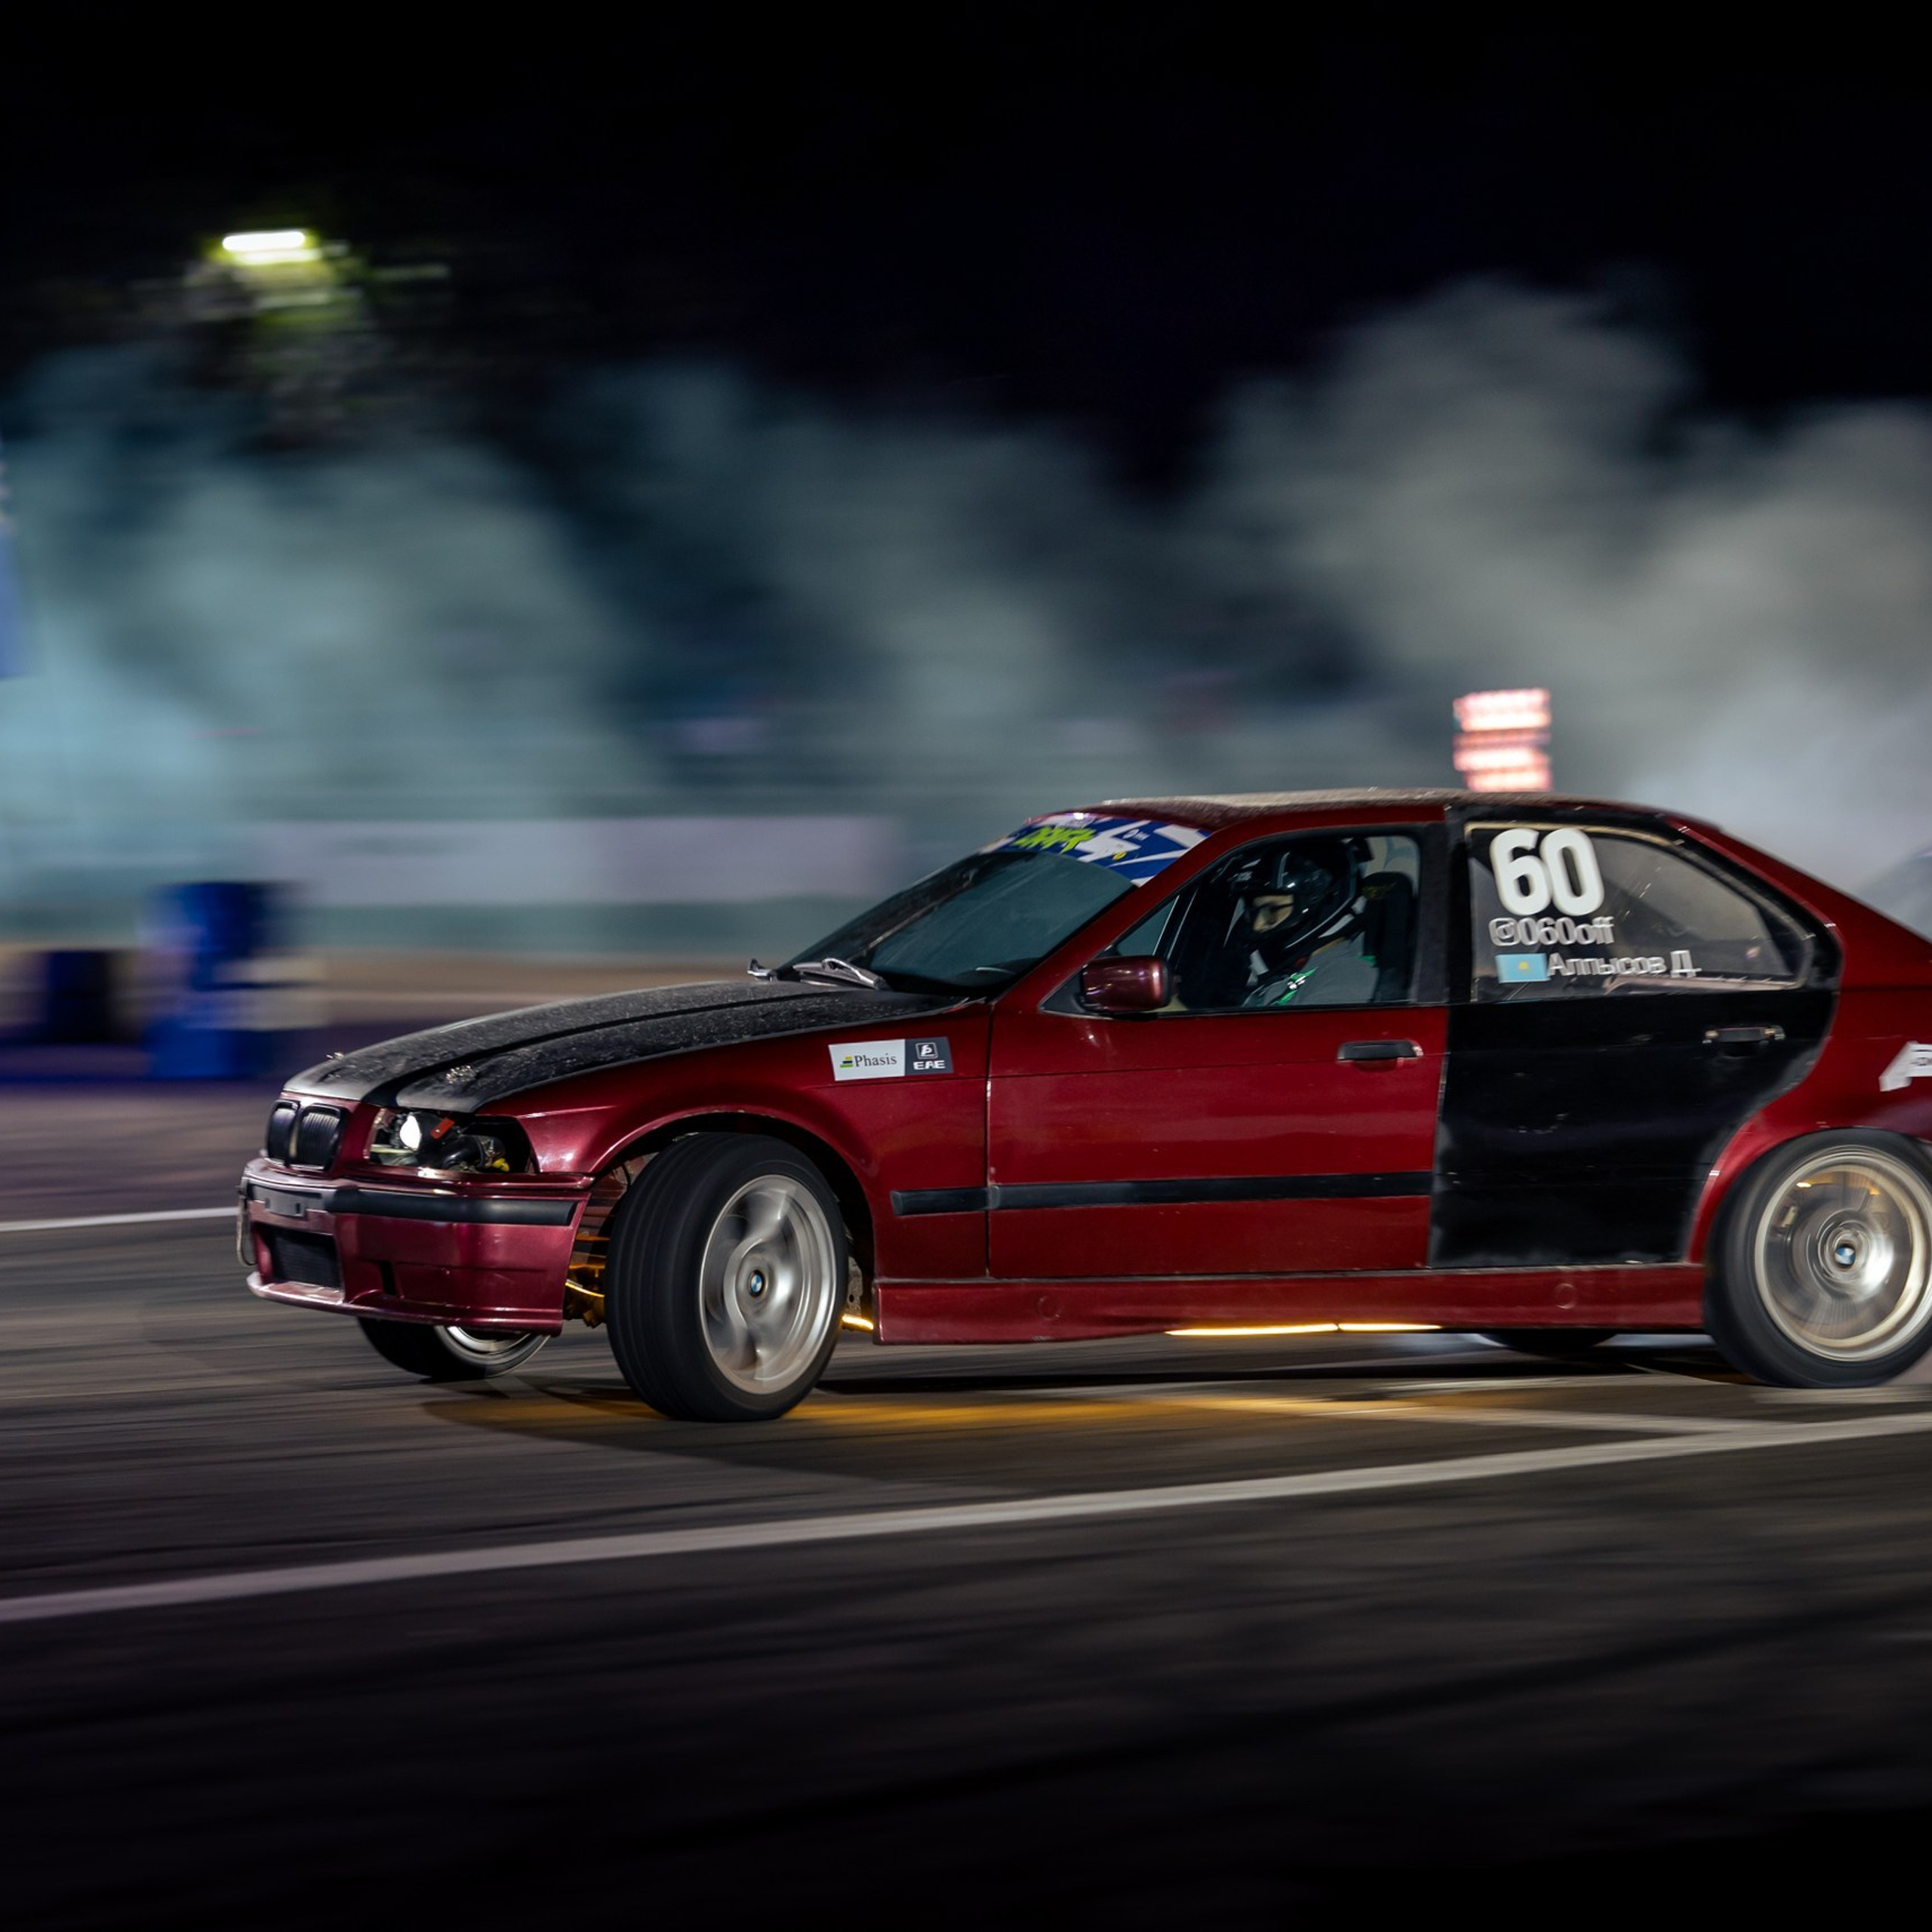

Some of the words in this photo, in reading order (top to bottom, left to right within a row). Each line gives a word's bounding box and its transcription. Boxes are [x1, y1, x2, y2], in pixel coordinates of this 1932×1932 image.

[1490, 828, 1604, 916] 60
[1489, 916, 1614, 946] @060off
[854, 1053, 897, 1067] Phasis
